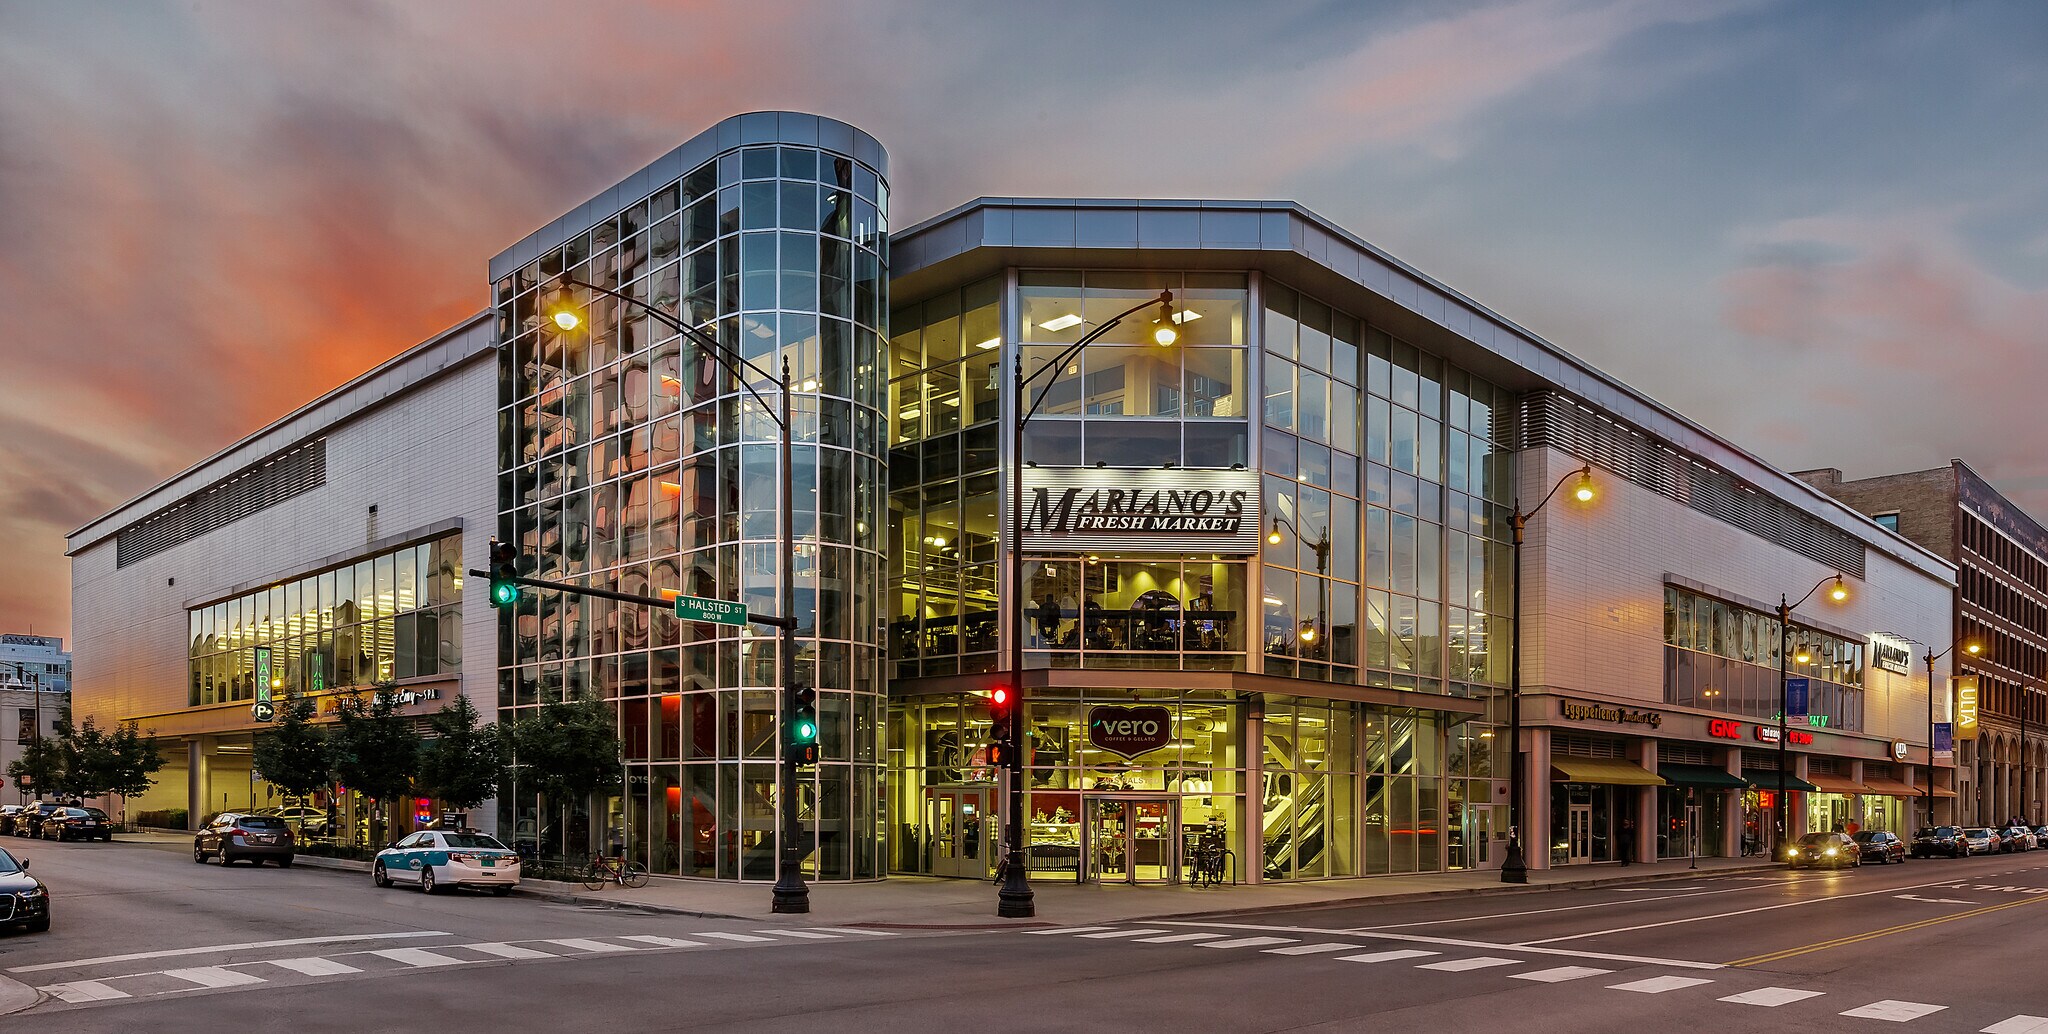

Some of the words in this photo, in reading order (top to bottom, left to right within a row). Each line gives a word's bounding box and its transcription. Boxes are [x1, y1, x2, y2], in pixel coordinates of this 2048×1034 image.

[1022, 487, 1247, 533] MARIANO'S
[1078, 516, 1147, 530] FRESH
[1150, 517, 1238, 531] MARKET
[688, 599, 731, 614] HALSTED
[734, 606, 742, 614] ST
[702, 612, 716, 620] 800
[258, 650, 269, 701] PARK
[256, 706, 267, 717] P
[1960, 688, 1976, 726] ULTA
[1102, 720, 1159, 736] vero
[1711, 719, 1742, 739] GNC
